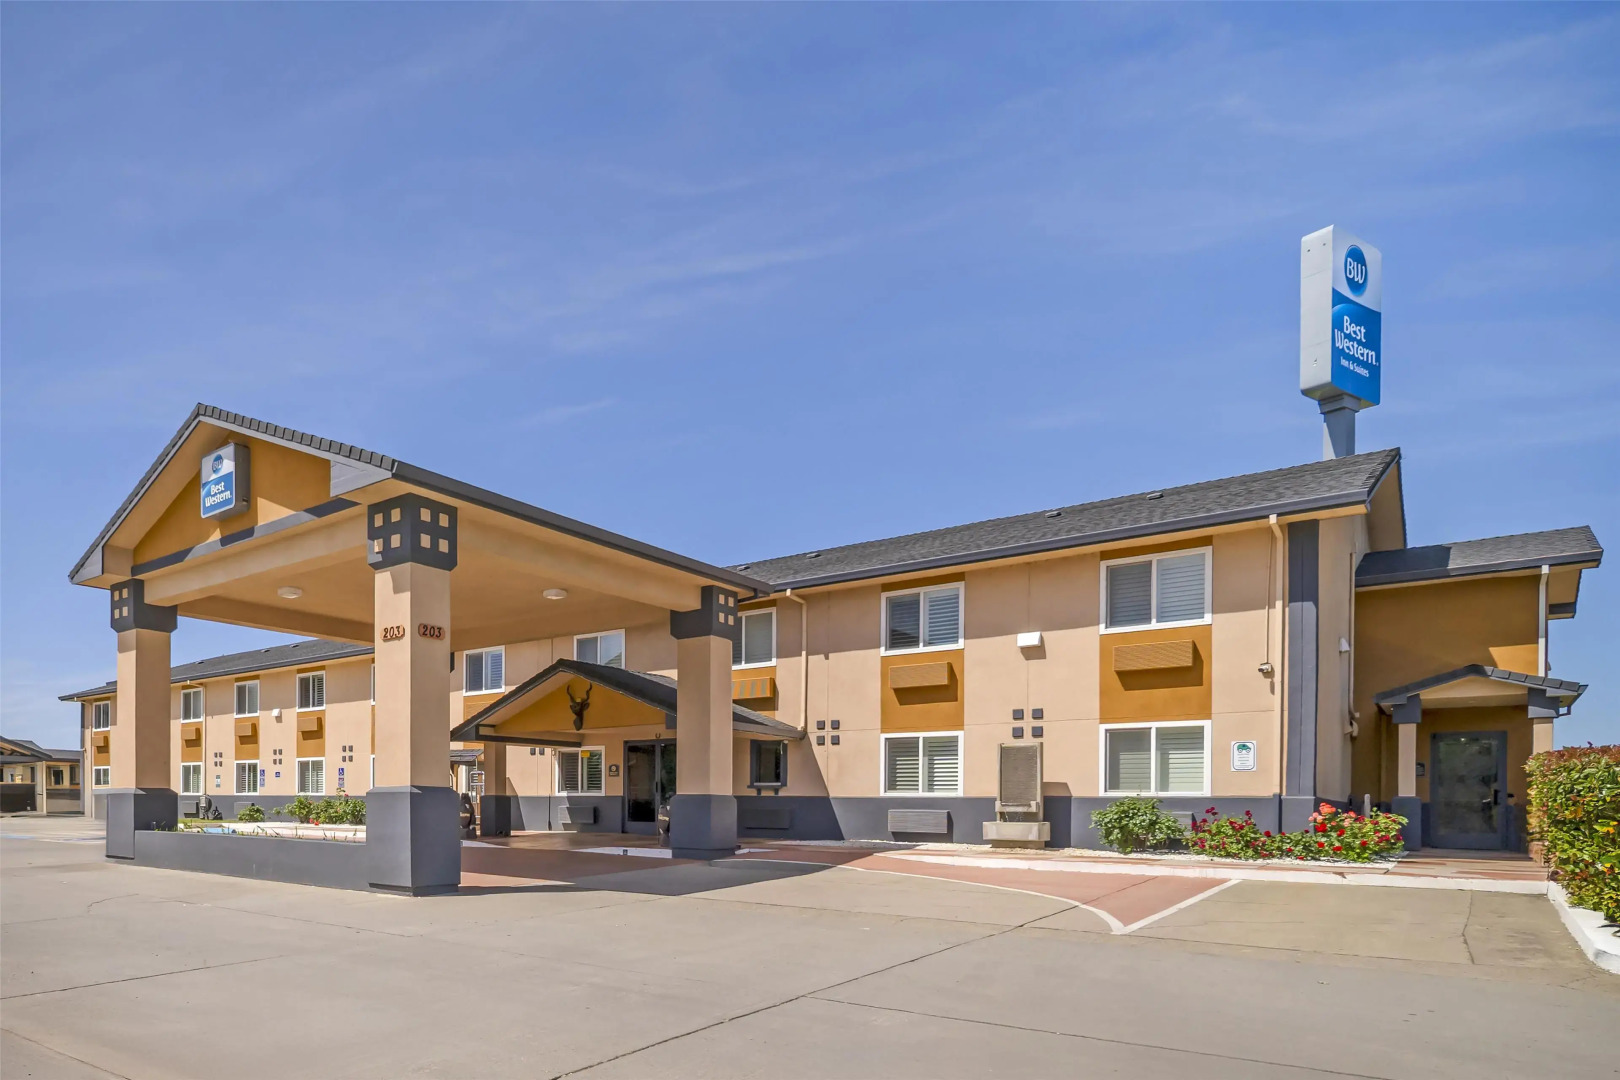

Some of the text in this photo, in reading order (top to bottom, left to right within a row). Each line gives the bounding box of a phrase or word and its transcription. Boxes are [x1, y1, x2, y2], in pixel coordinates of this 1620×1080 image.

[1346, 257, 1366, 284] BW
[1343, 315, 1366, 342] Best
[1340, 356, 1349, 368] Inn
[210, 482, 225, 494] Best
[383, 625, 401, 639] 203
[422, 624, 442, 638] 203
